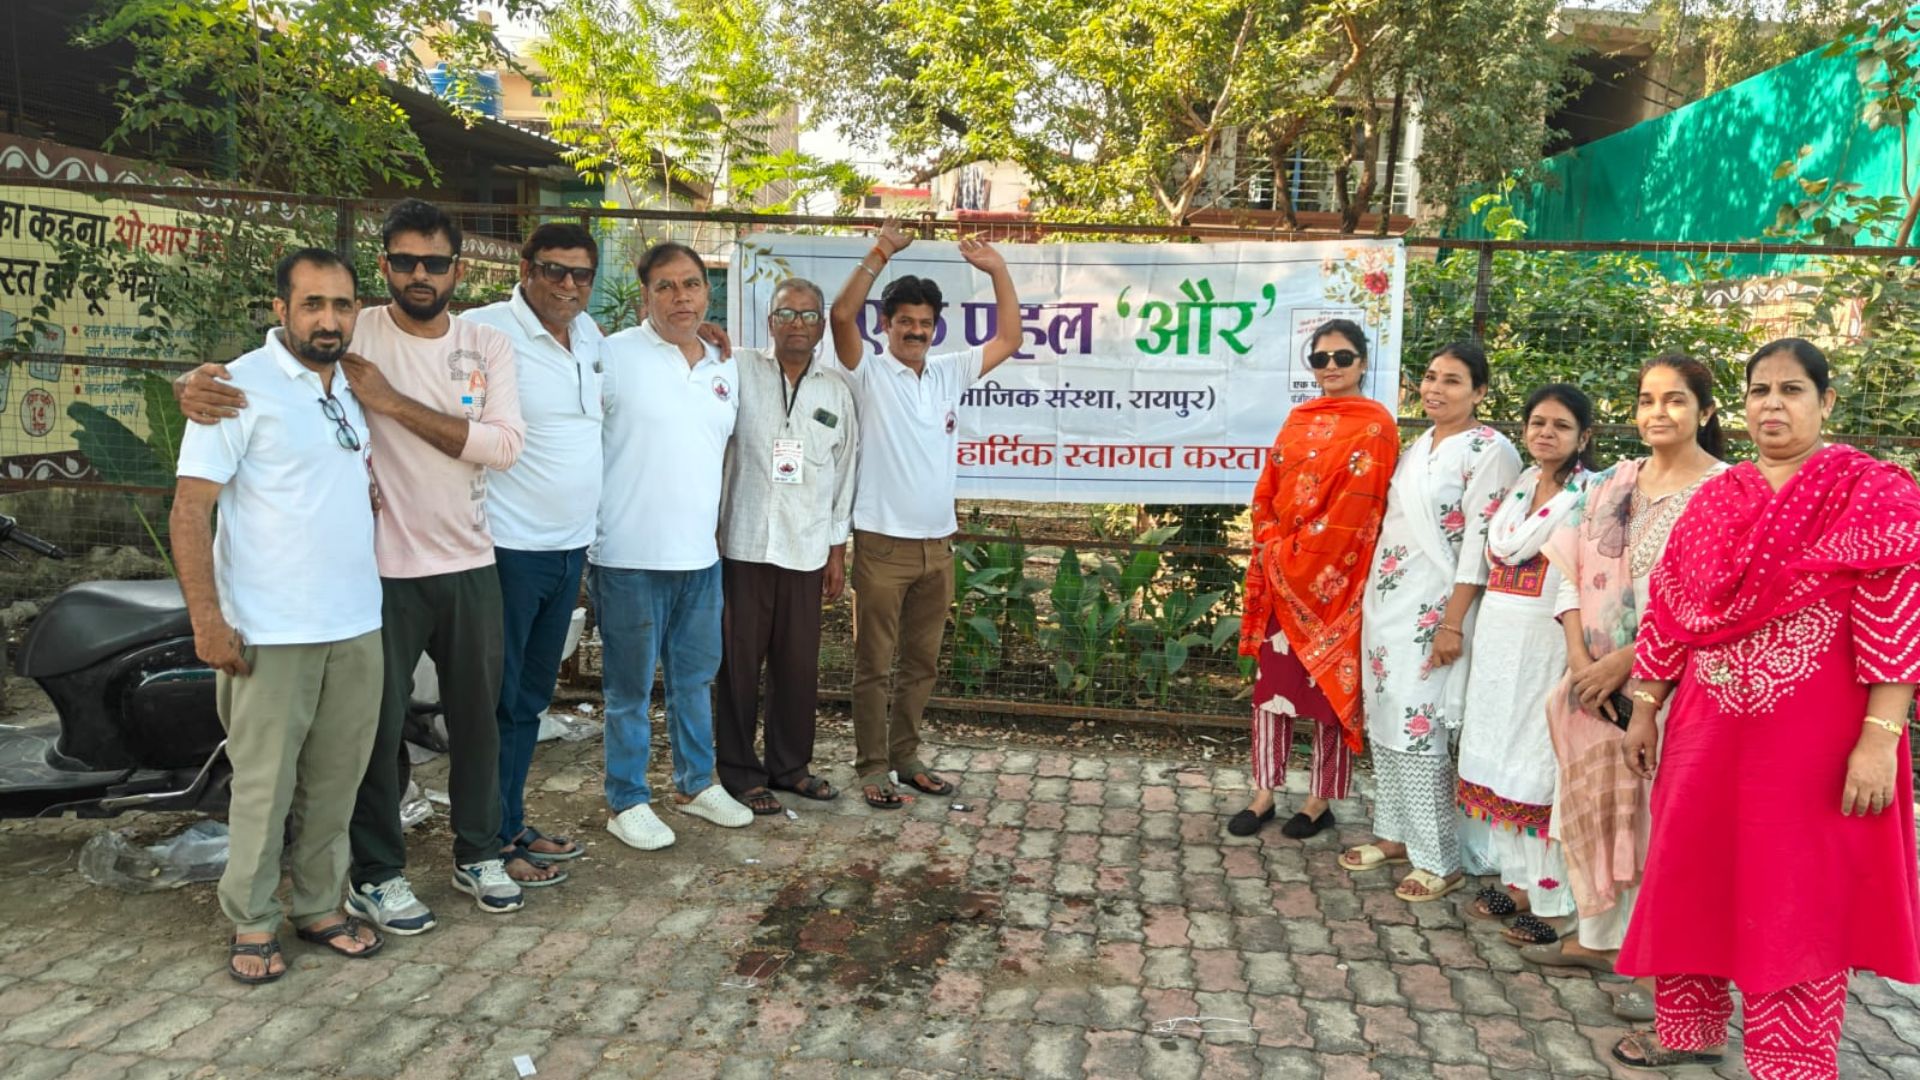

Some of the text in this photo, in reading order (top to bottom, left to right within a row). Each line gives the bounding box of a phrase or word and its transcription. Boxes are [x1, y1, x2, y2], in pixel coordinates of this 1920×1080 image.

[1044, 382, 1122, 411] संस्था,
[1128, 385, 1216, 418] रायपुर)
[957, 433, 1056, 467] हार्दिक
[1063, 444, 1175, 469] स्वागत
